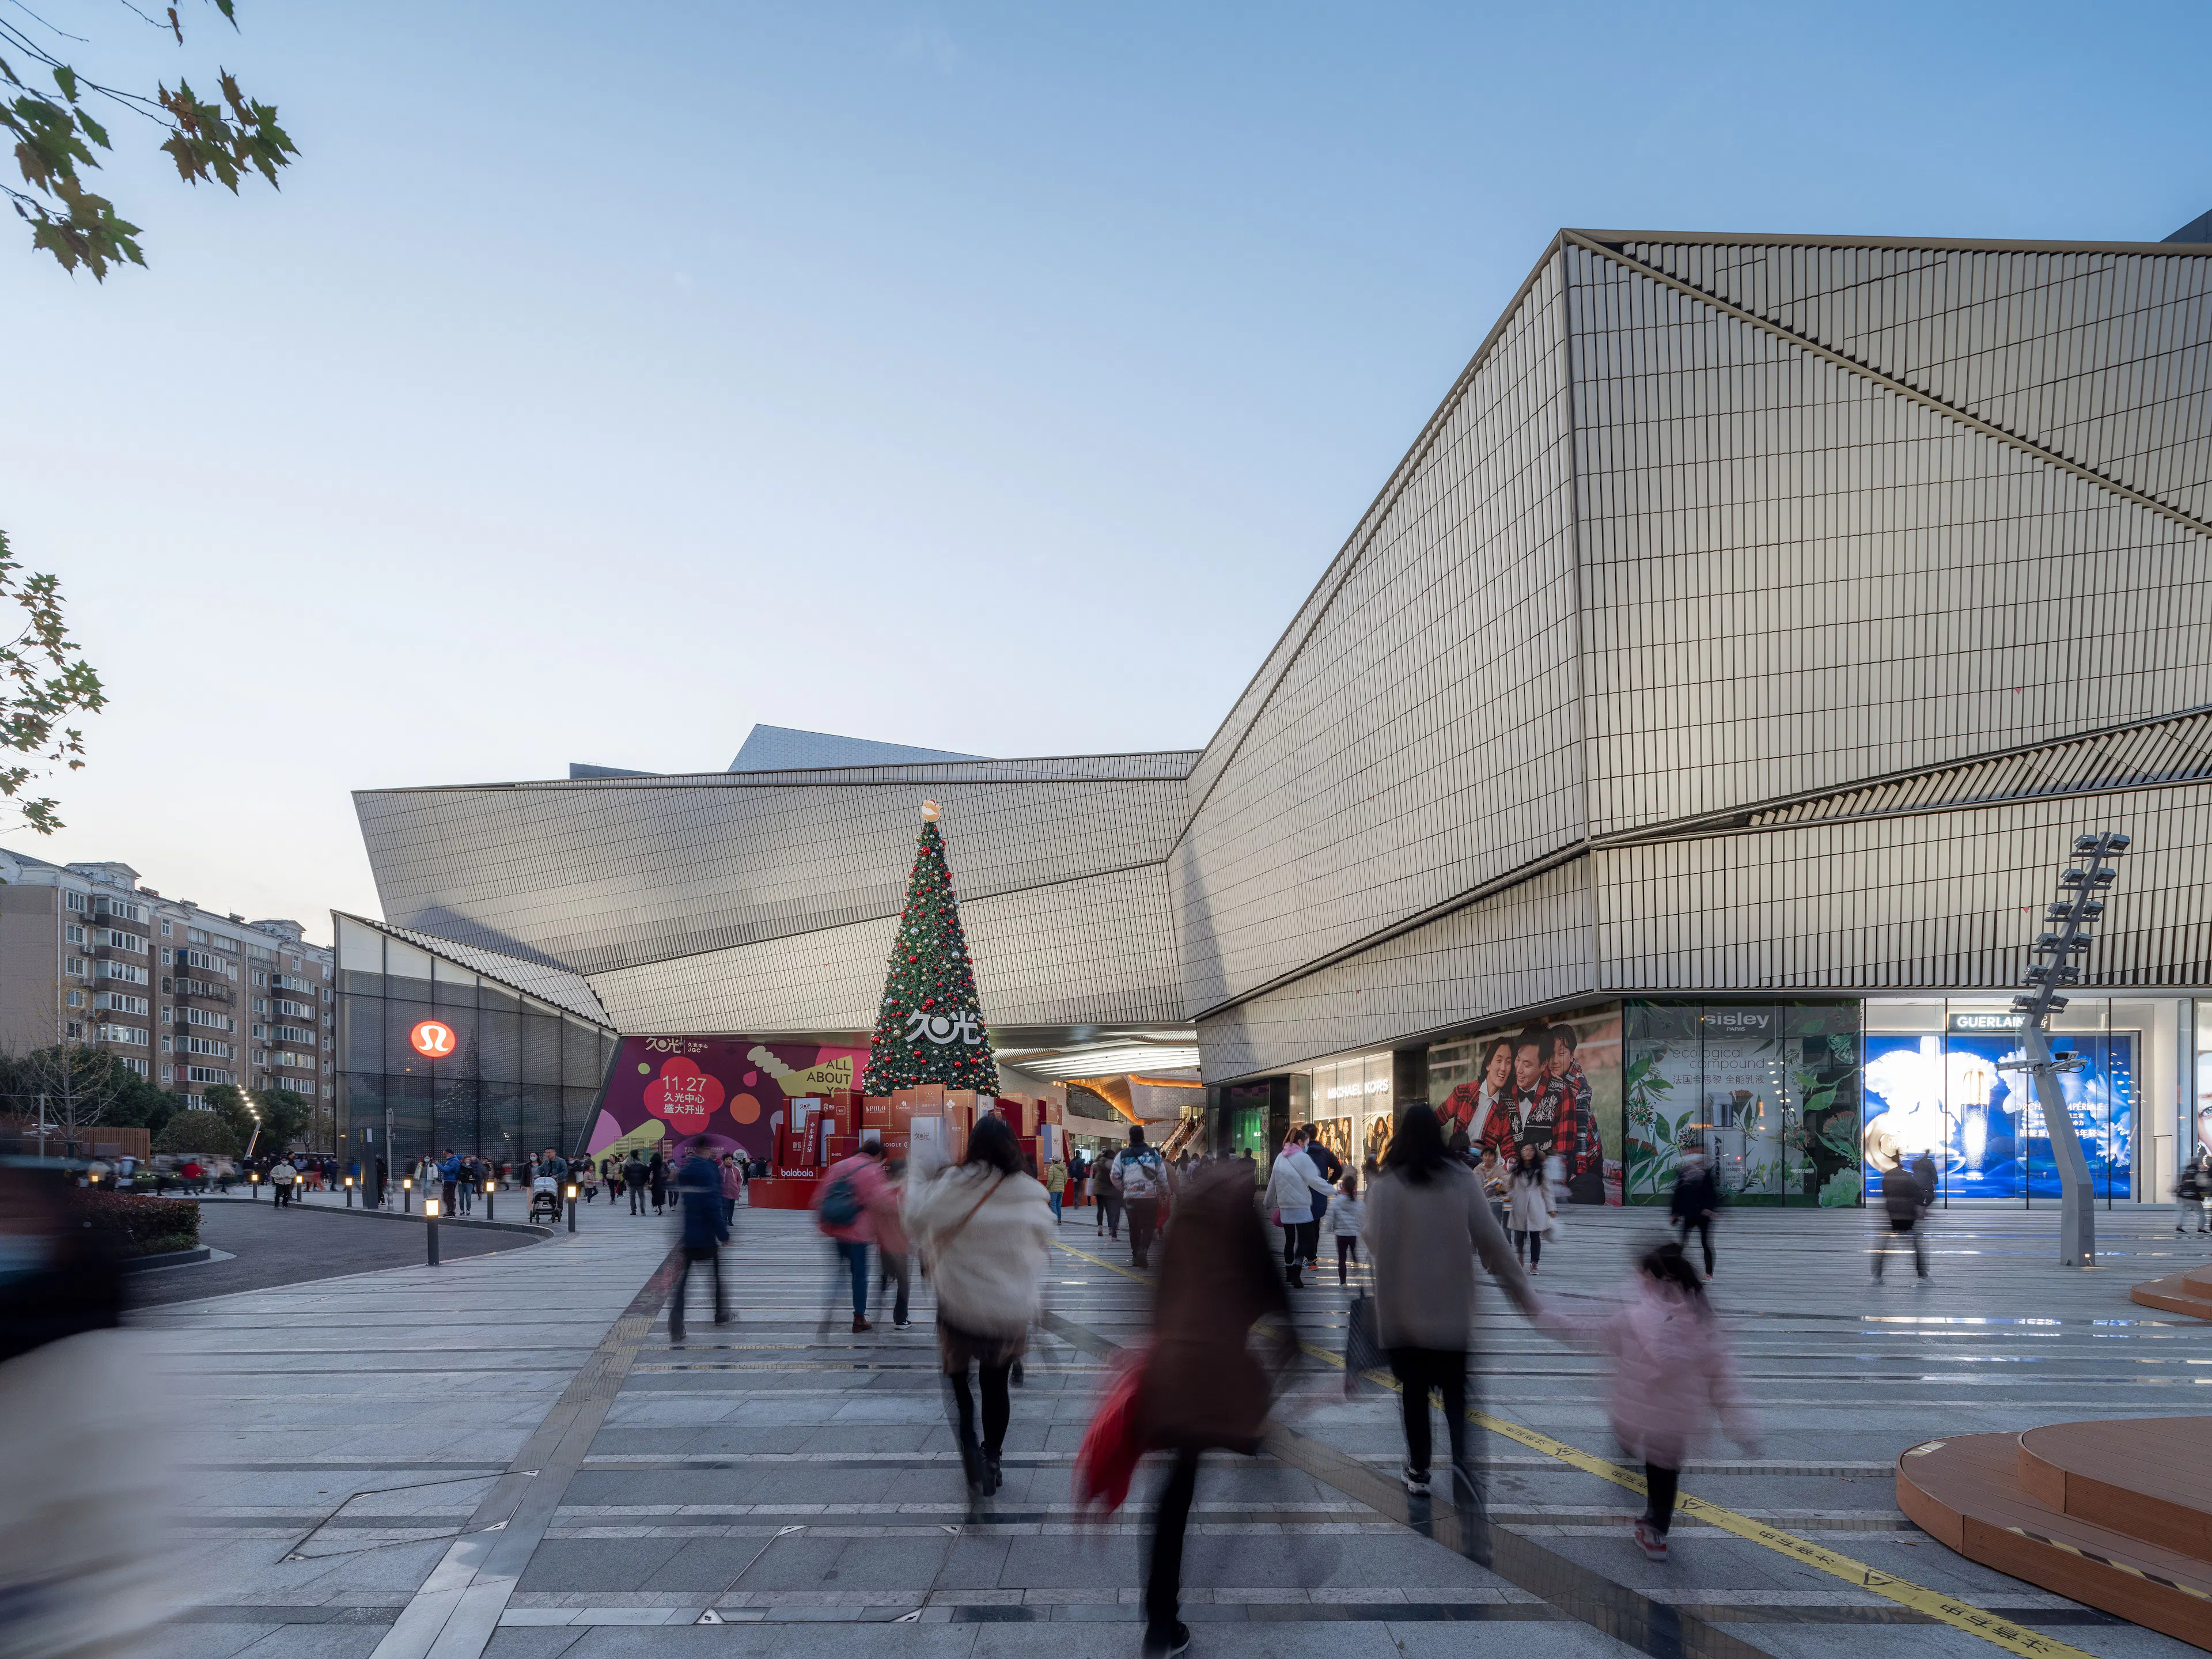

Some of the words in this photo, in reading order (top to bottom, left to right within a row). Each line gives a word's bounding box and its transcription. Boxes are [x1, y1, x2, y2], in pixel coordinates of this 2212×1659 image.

[1703, 1012, 1770, 1028] sisley
[1957, 1016, 2025, 1027] GUERLAIN
[1672, 1047, 1743, 1060] ecological
[826, 1059, 851, 1071] ALL
[1690, 1058, 1764, 1071] compound
[662, 1075, 707, 1092] 11.27
[806, 1071, 851, 1085] ABOUT
[1673, 1074, 1721, 1084] 法国希思黎
[1725, 1074, 1765, 1084] 全能乳液
[1327, 1084, 1362, 1100] MICHAEL
[1364, 1079, 1389, 1093] KORS
[664, 1092, 705, 1104] 久光中心
[664, 1103, 705, 1115] 盛大开业
[781, 1168, 813, 1177] balabala
